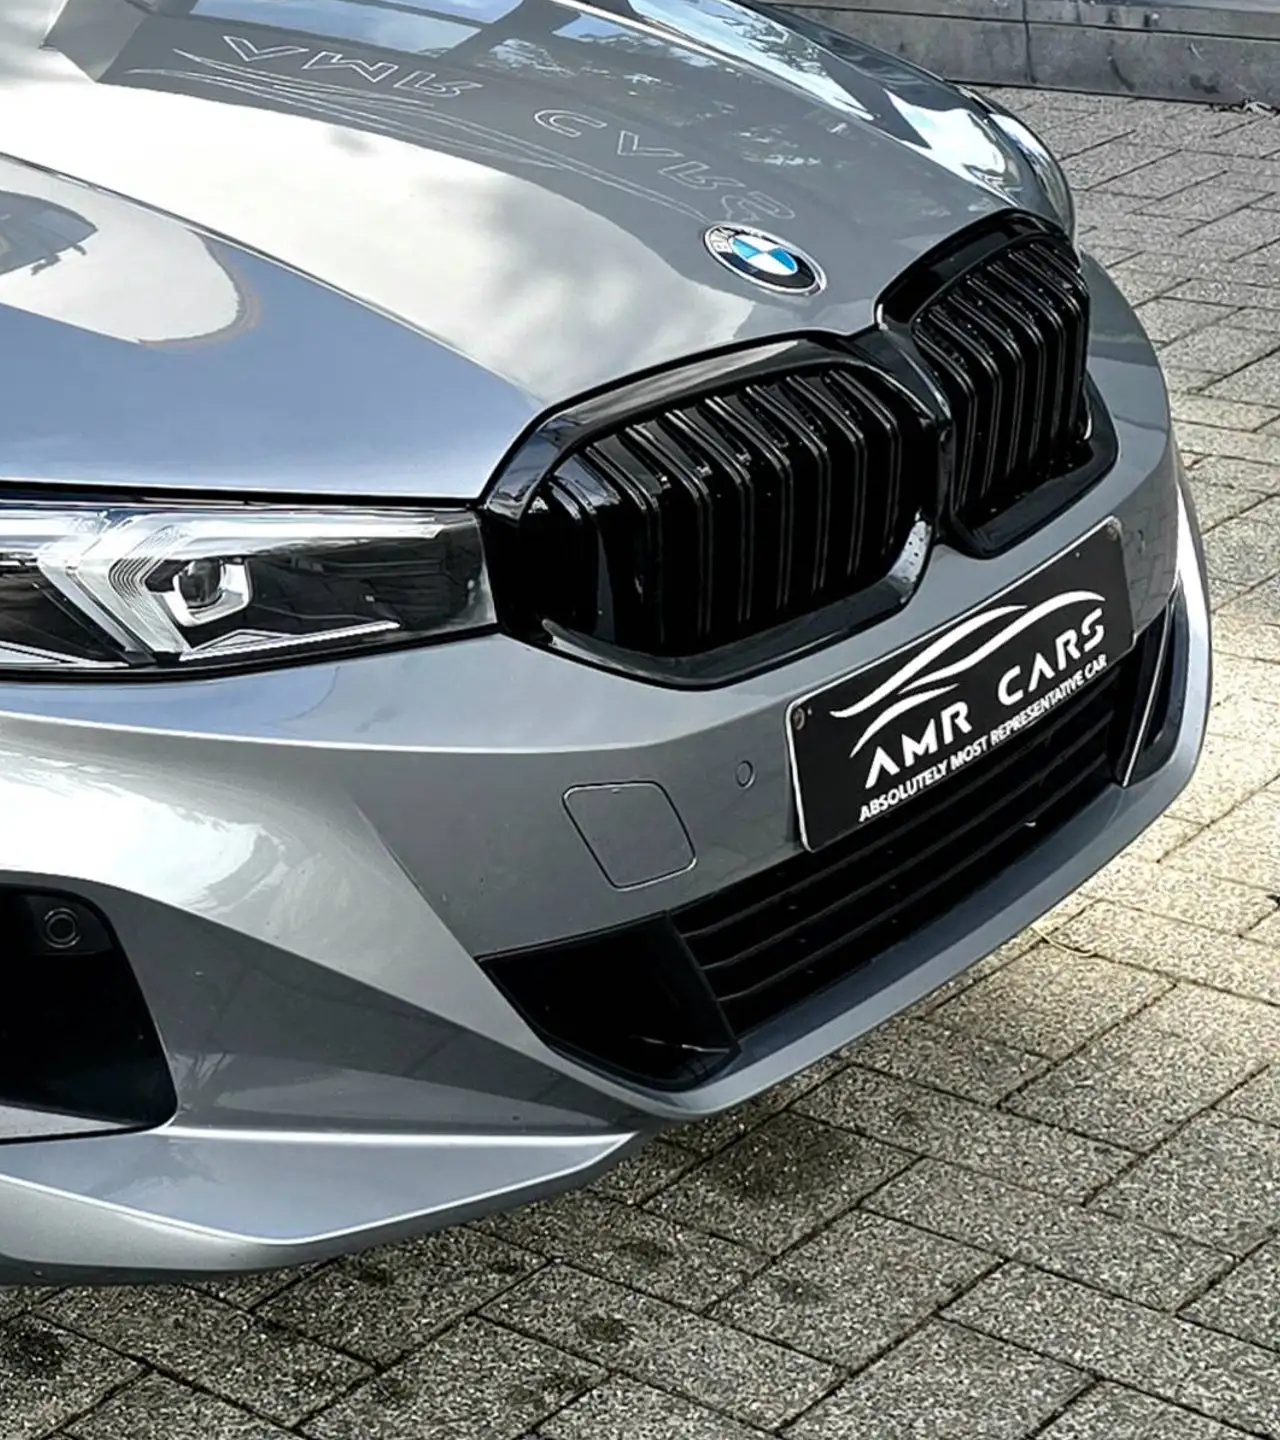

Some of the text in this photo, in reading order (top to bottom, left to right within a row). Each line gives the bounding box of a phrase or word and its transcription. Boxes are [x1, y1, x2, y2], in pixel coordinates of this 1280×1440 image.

[859, 653, 1109, 822] ABSOLUTELY MOST REPRESENTATIVE CAR
[864, 607, 1106, 789] AMR CARS
